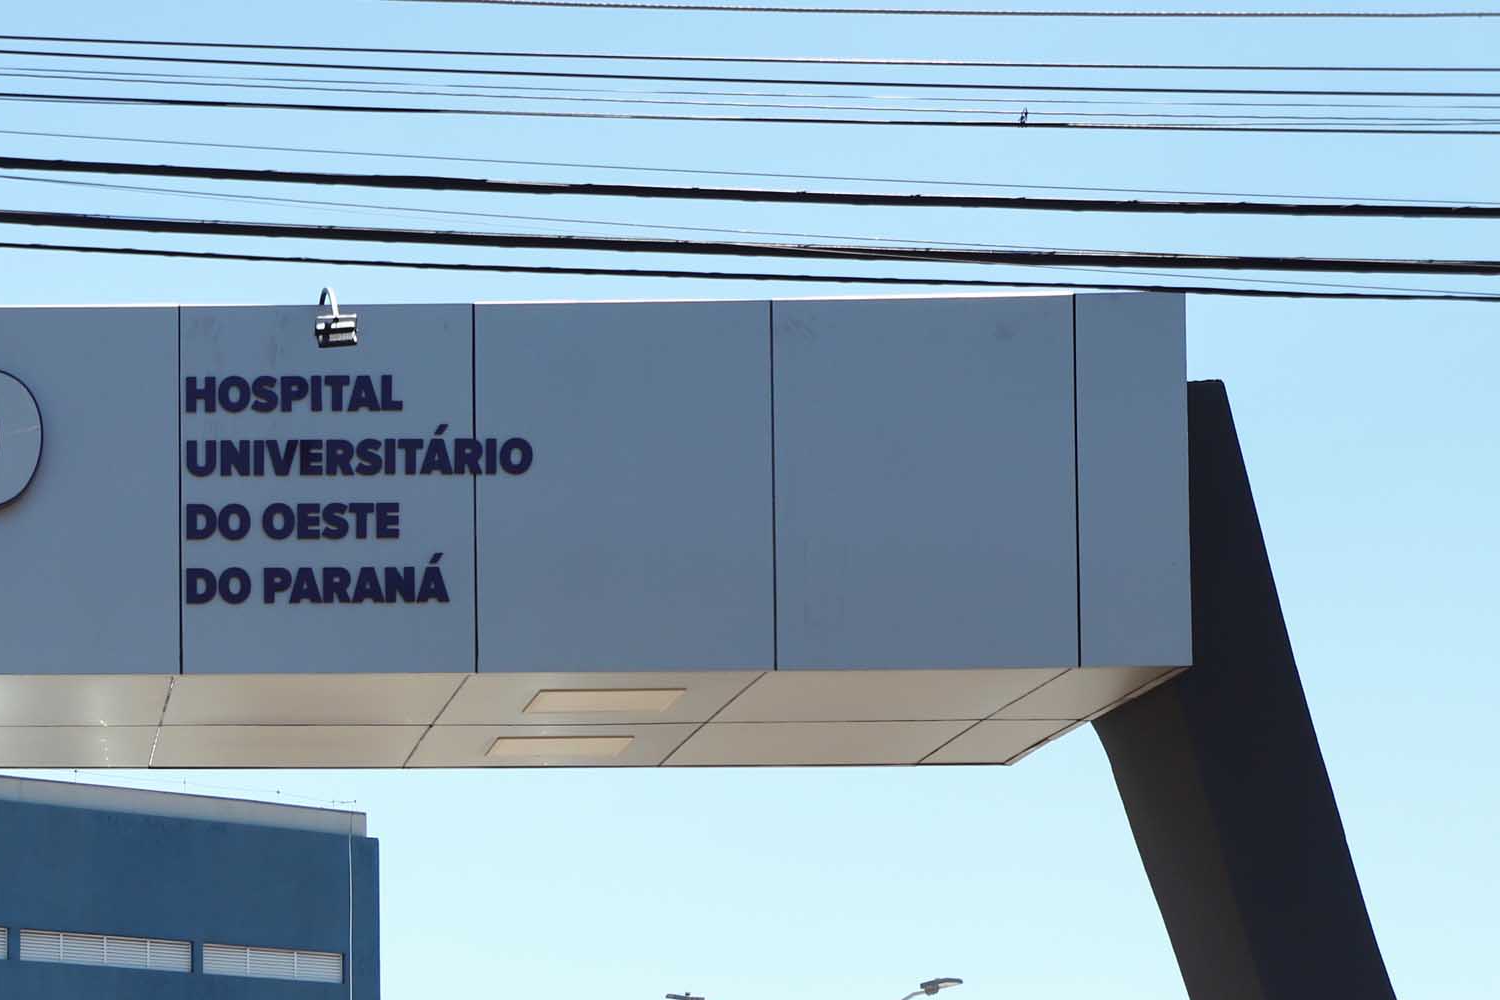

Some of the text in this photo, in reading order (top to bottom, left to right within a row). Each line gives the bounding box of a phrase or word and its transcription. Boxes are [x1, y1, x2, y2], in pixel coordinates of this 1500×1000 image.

[185, 375, 404, 413] HOSPITAL
[186, 423, 534, 477] UNIVERSITÁRIO
[186, 502, 400, 540] DO OESTE
[186, 552, 450, 604] DO PARANÁ
